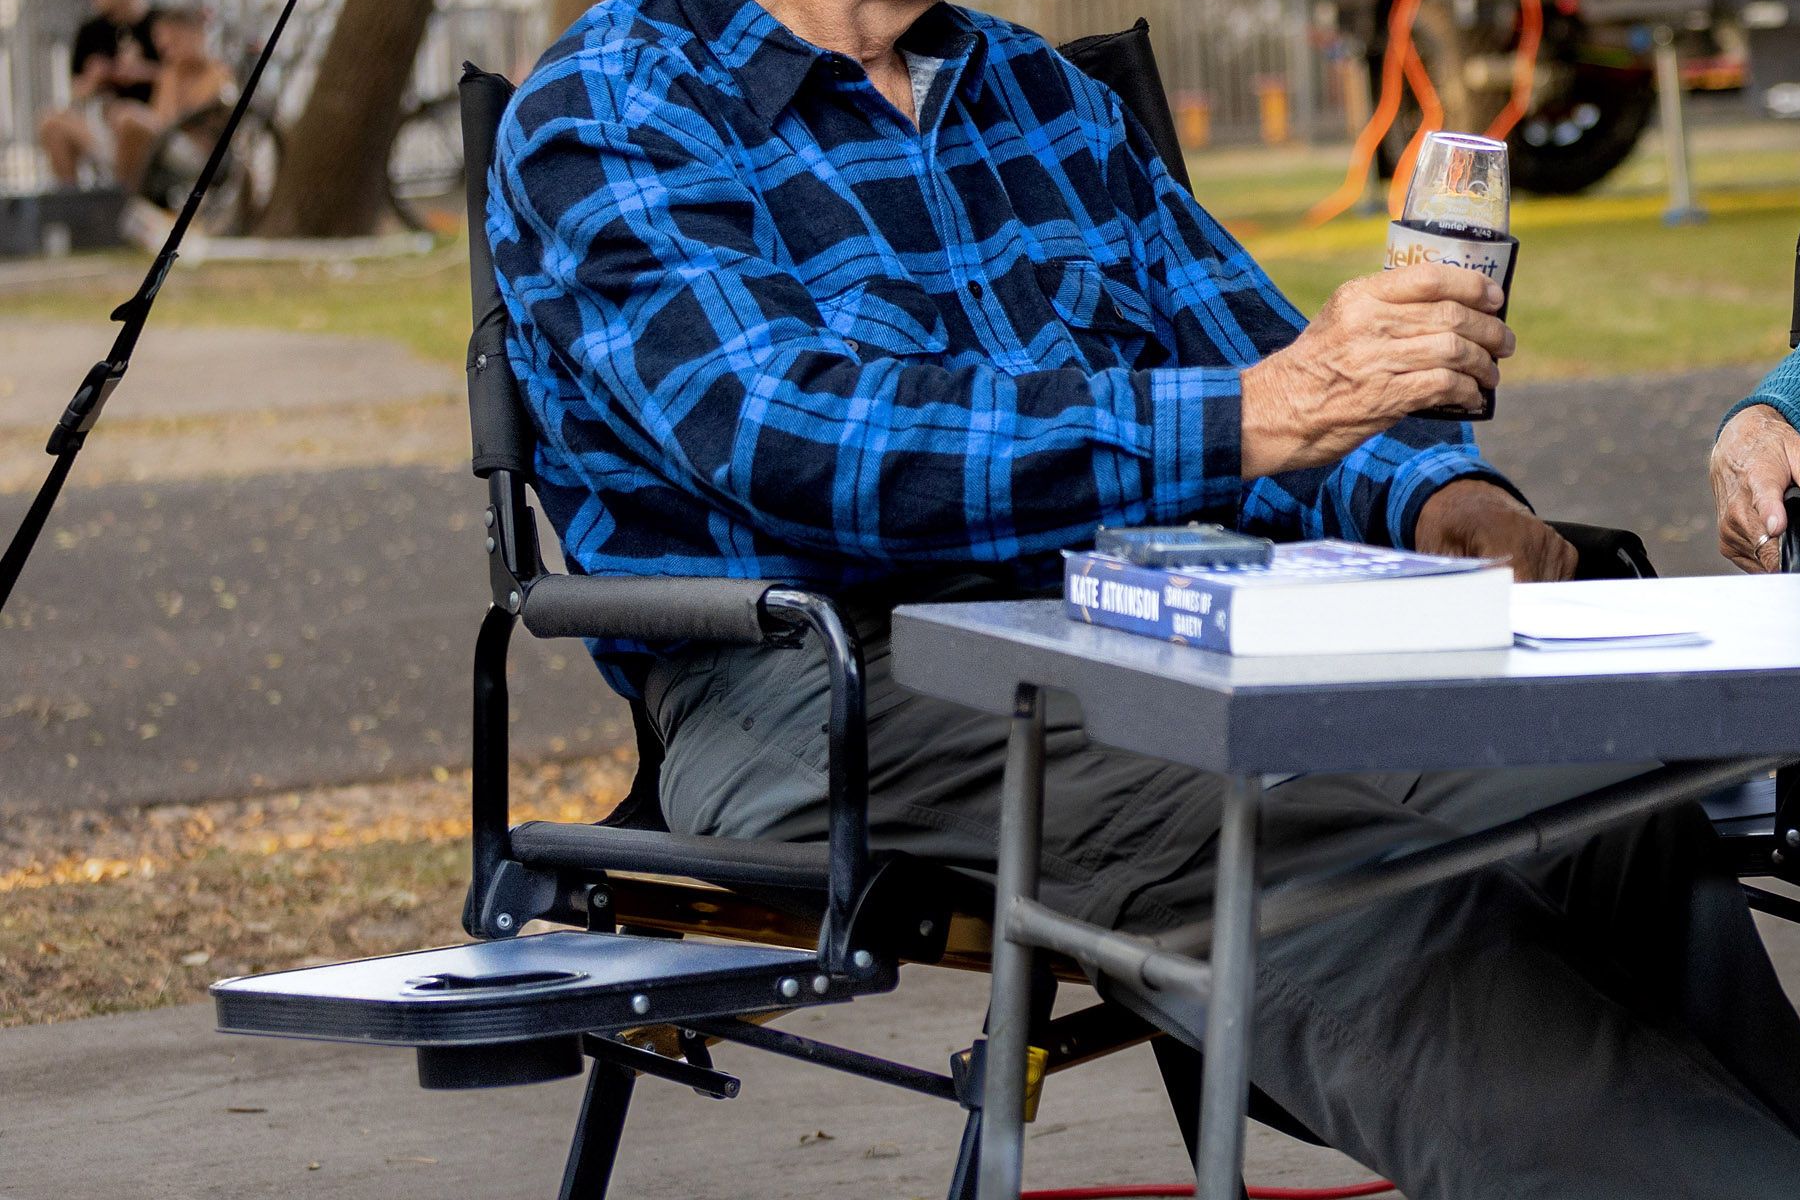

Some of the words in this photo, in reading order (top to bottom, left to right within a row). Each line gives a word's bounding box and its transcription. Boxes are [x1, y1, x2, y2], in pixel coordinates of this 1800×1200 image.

[1070, 574, 1099, 609] KATE
[1101, 580, 1160, 622] ATKINSON
[1164, 585, 1200, 613] SHRINES
[1201, 592, 1212, 615] OF
[1172, 612, 1203, 638] GAIETY
